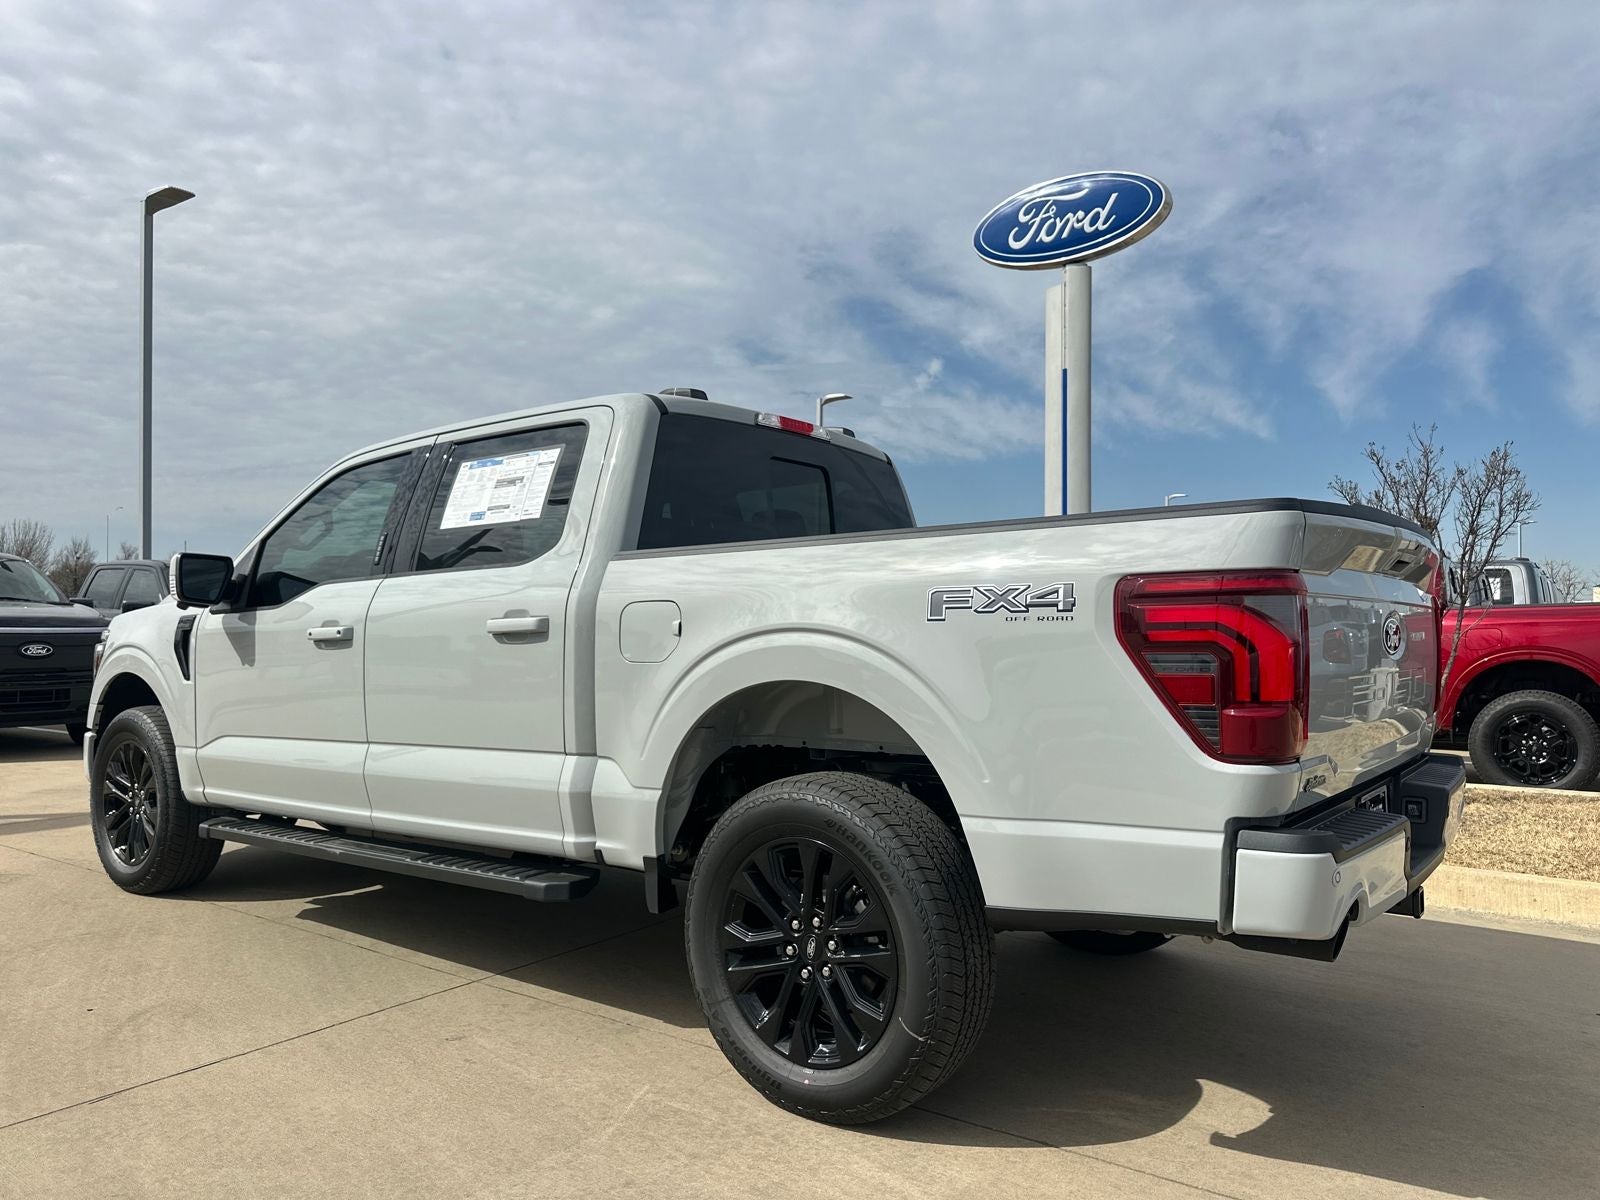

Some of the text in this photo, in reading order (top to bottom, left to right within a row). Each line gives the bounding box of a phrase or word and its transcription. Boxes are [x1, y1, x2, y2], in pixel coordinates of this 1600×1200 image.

[1008, 188, 1118, 249] Ford
[926, 582, 1076, 622] FX4
[27, 646, 48, 654] Ford
